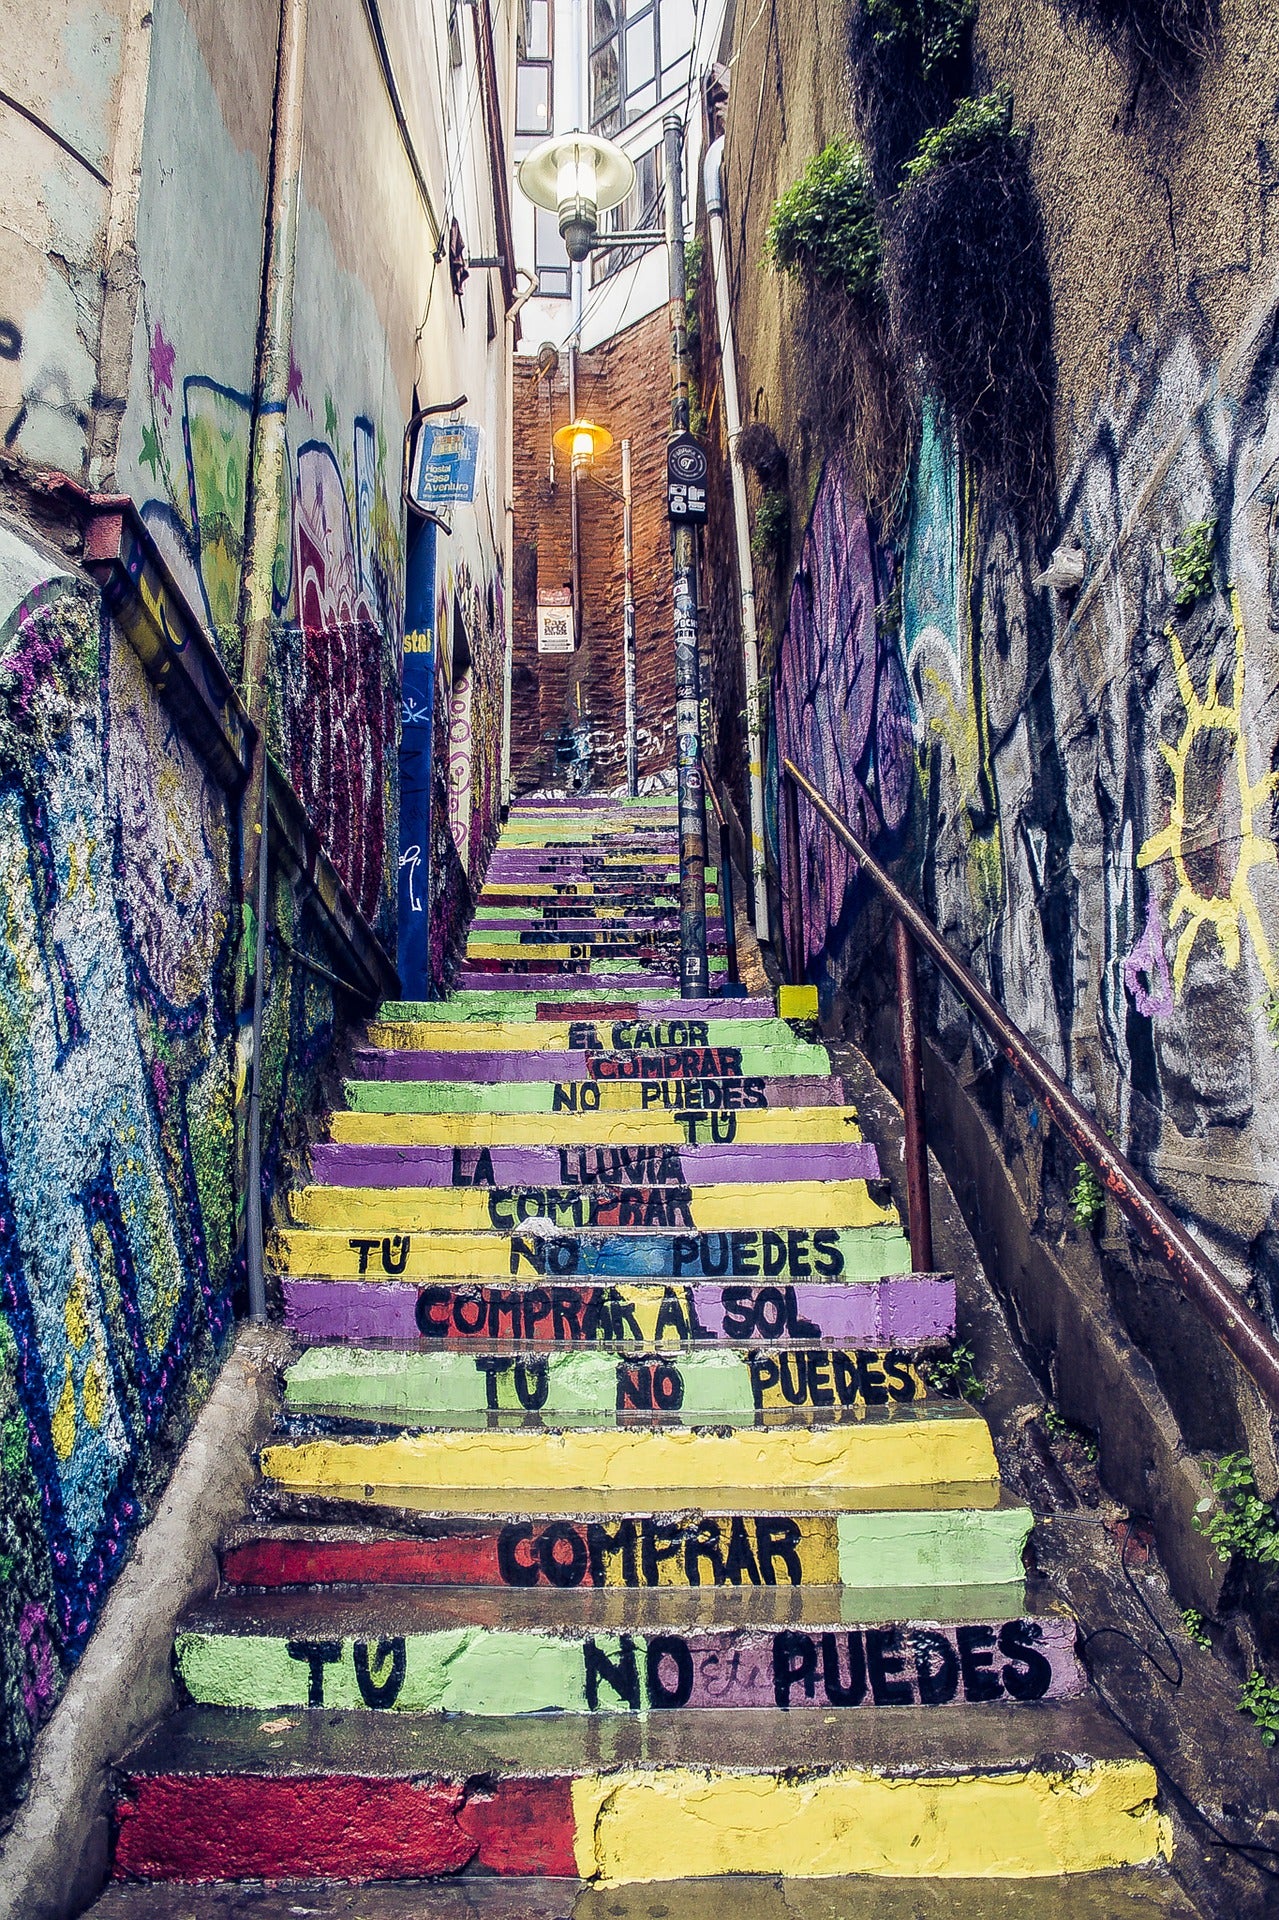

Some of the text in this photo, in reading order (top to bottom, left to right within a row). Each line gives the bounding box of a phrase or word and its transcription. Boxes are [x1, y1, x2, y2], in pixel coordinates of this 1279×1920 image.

[424, 473, 449, 482] Casa
[424, 482, 468, 492] Aventura
[426, 464, 451, 473] Hostal
[568, 1020, 709, 1049] EL CALOR
[589, 1049, 743, 1079] COMPRAR
[552, 1078, 768, 1111] NO PUEDES
[452, 1148, 687, 1186] LA LLUVIA
[488, 1187, 697, 1230] COMPRAR
[511, 1235, 579, 1275] NO
[671, 1230, 844, 1277] PUEDES
[415, 1286, 645, 1340] COMPRAR
[721, 1286, 821, 1340] SOL
[615, 1360, 684, 1411] NO
[747, 1349, 916, 1410] PUEDES
[499, 1516, 801, 1588] COMPRAR
[583, 1633, 693, 1711] NO
[772, 1619, 1052, 1711] PUEDES
